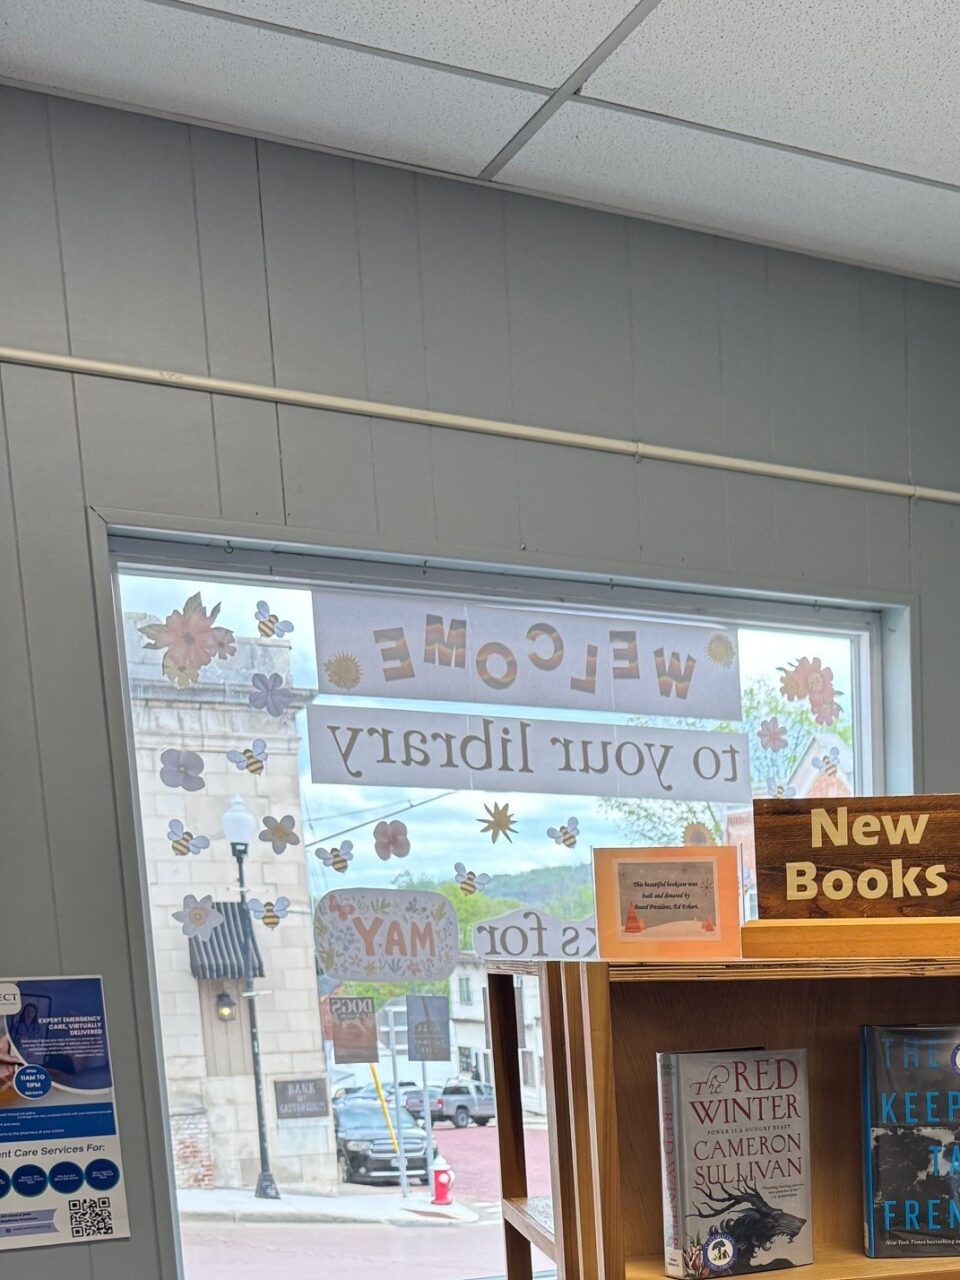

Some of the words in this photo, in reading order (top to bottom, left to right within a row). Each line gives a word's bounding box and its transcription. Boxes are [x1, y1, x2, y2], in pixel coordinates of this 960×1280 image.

[810, 806, 930, 848] New
[785, 858, 949, 901] Books
[880, 1036, 941, 1070] THE
[287, 1083, 316, 1095] BANK
[689, 1064, 730, 1096] The
[732, 1058, 799, 1093] RED
[689, 1094, 802, 1125] WINTER
[693, 1133, 801, 1161] CAMERON
[707, 1128, 730, 1136] POWER
[14, 1148, 38, 1157] Care
[41, 1145, 84, 1156] Services
[86, 1143, 105, 1152] For:
[694, 1157, 803, 1186] SULLIVAN
